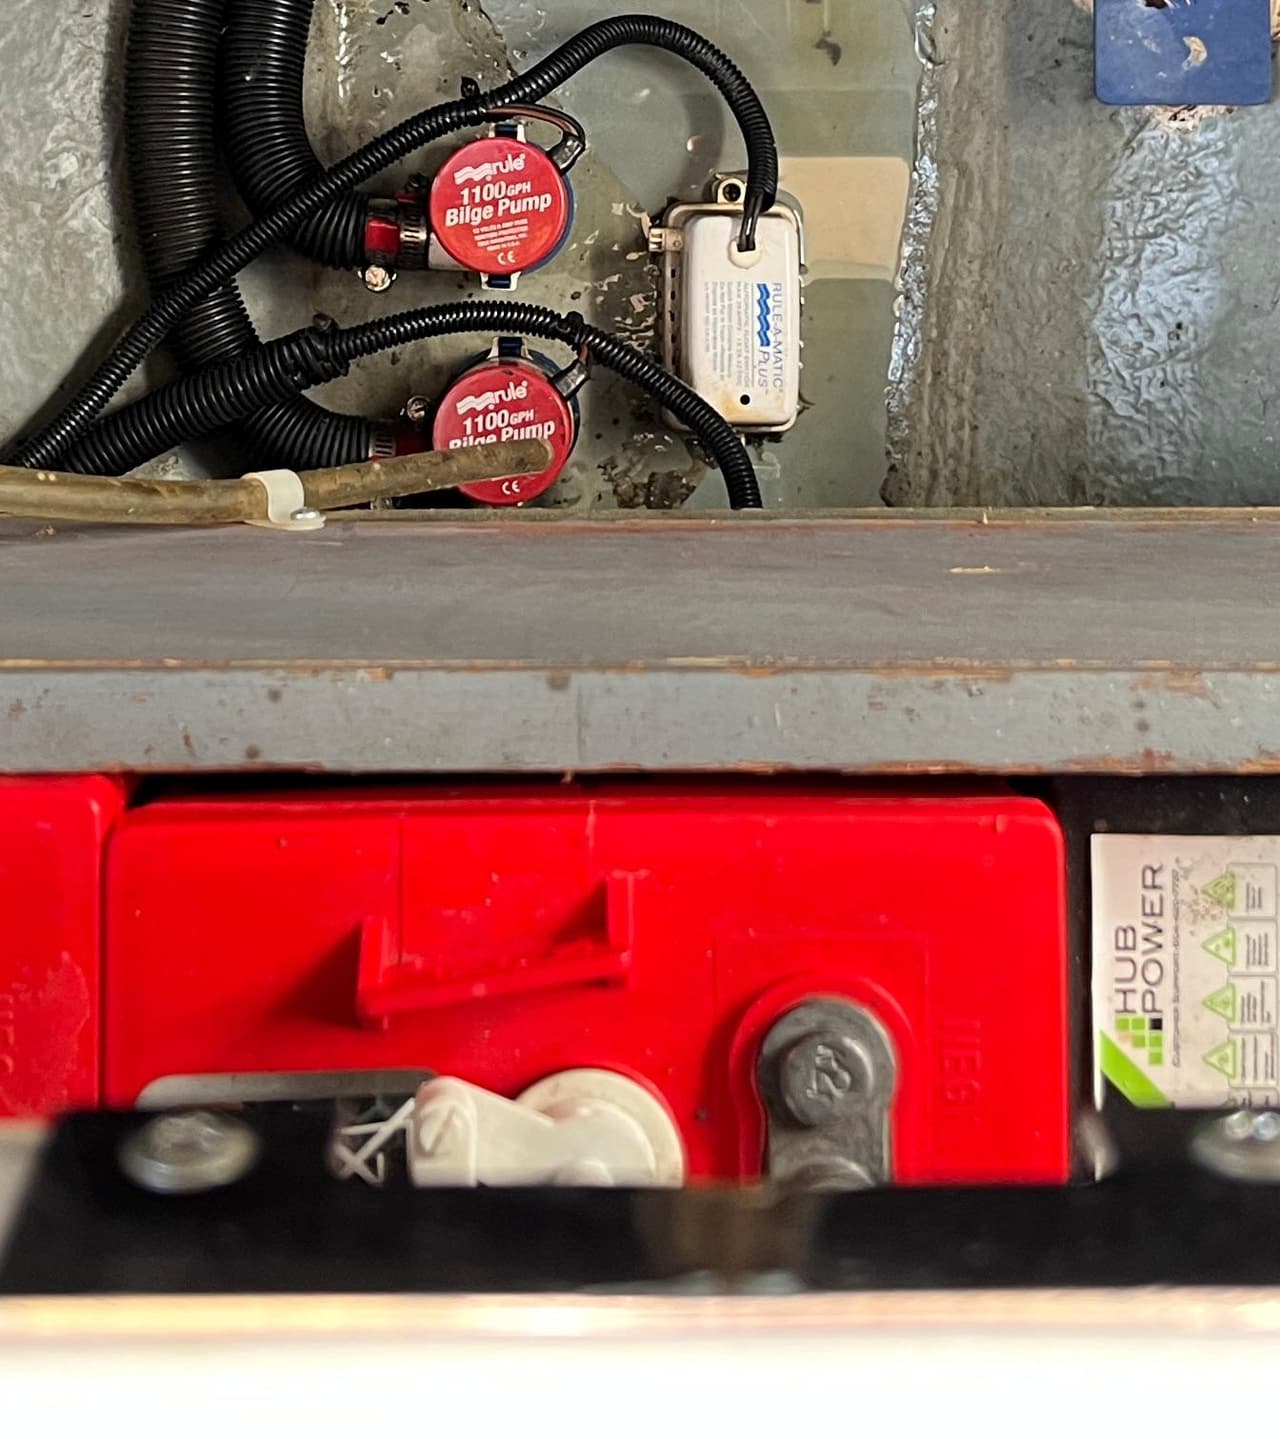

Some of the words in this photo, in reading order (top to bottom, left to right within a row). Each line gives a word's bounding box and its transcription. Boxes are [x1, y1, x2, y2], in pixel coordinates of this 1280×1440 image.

[445, 205, 494, 227] Bilge
[498, 193, 552, 216] Pump
[501, 421, 556, 442] Pump
[1115, 925, 1137, 1014] HUB
[1141, 864, 1164, 1014] POWER
